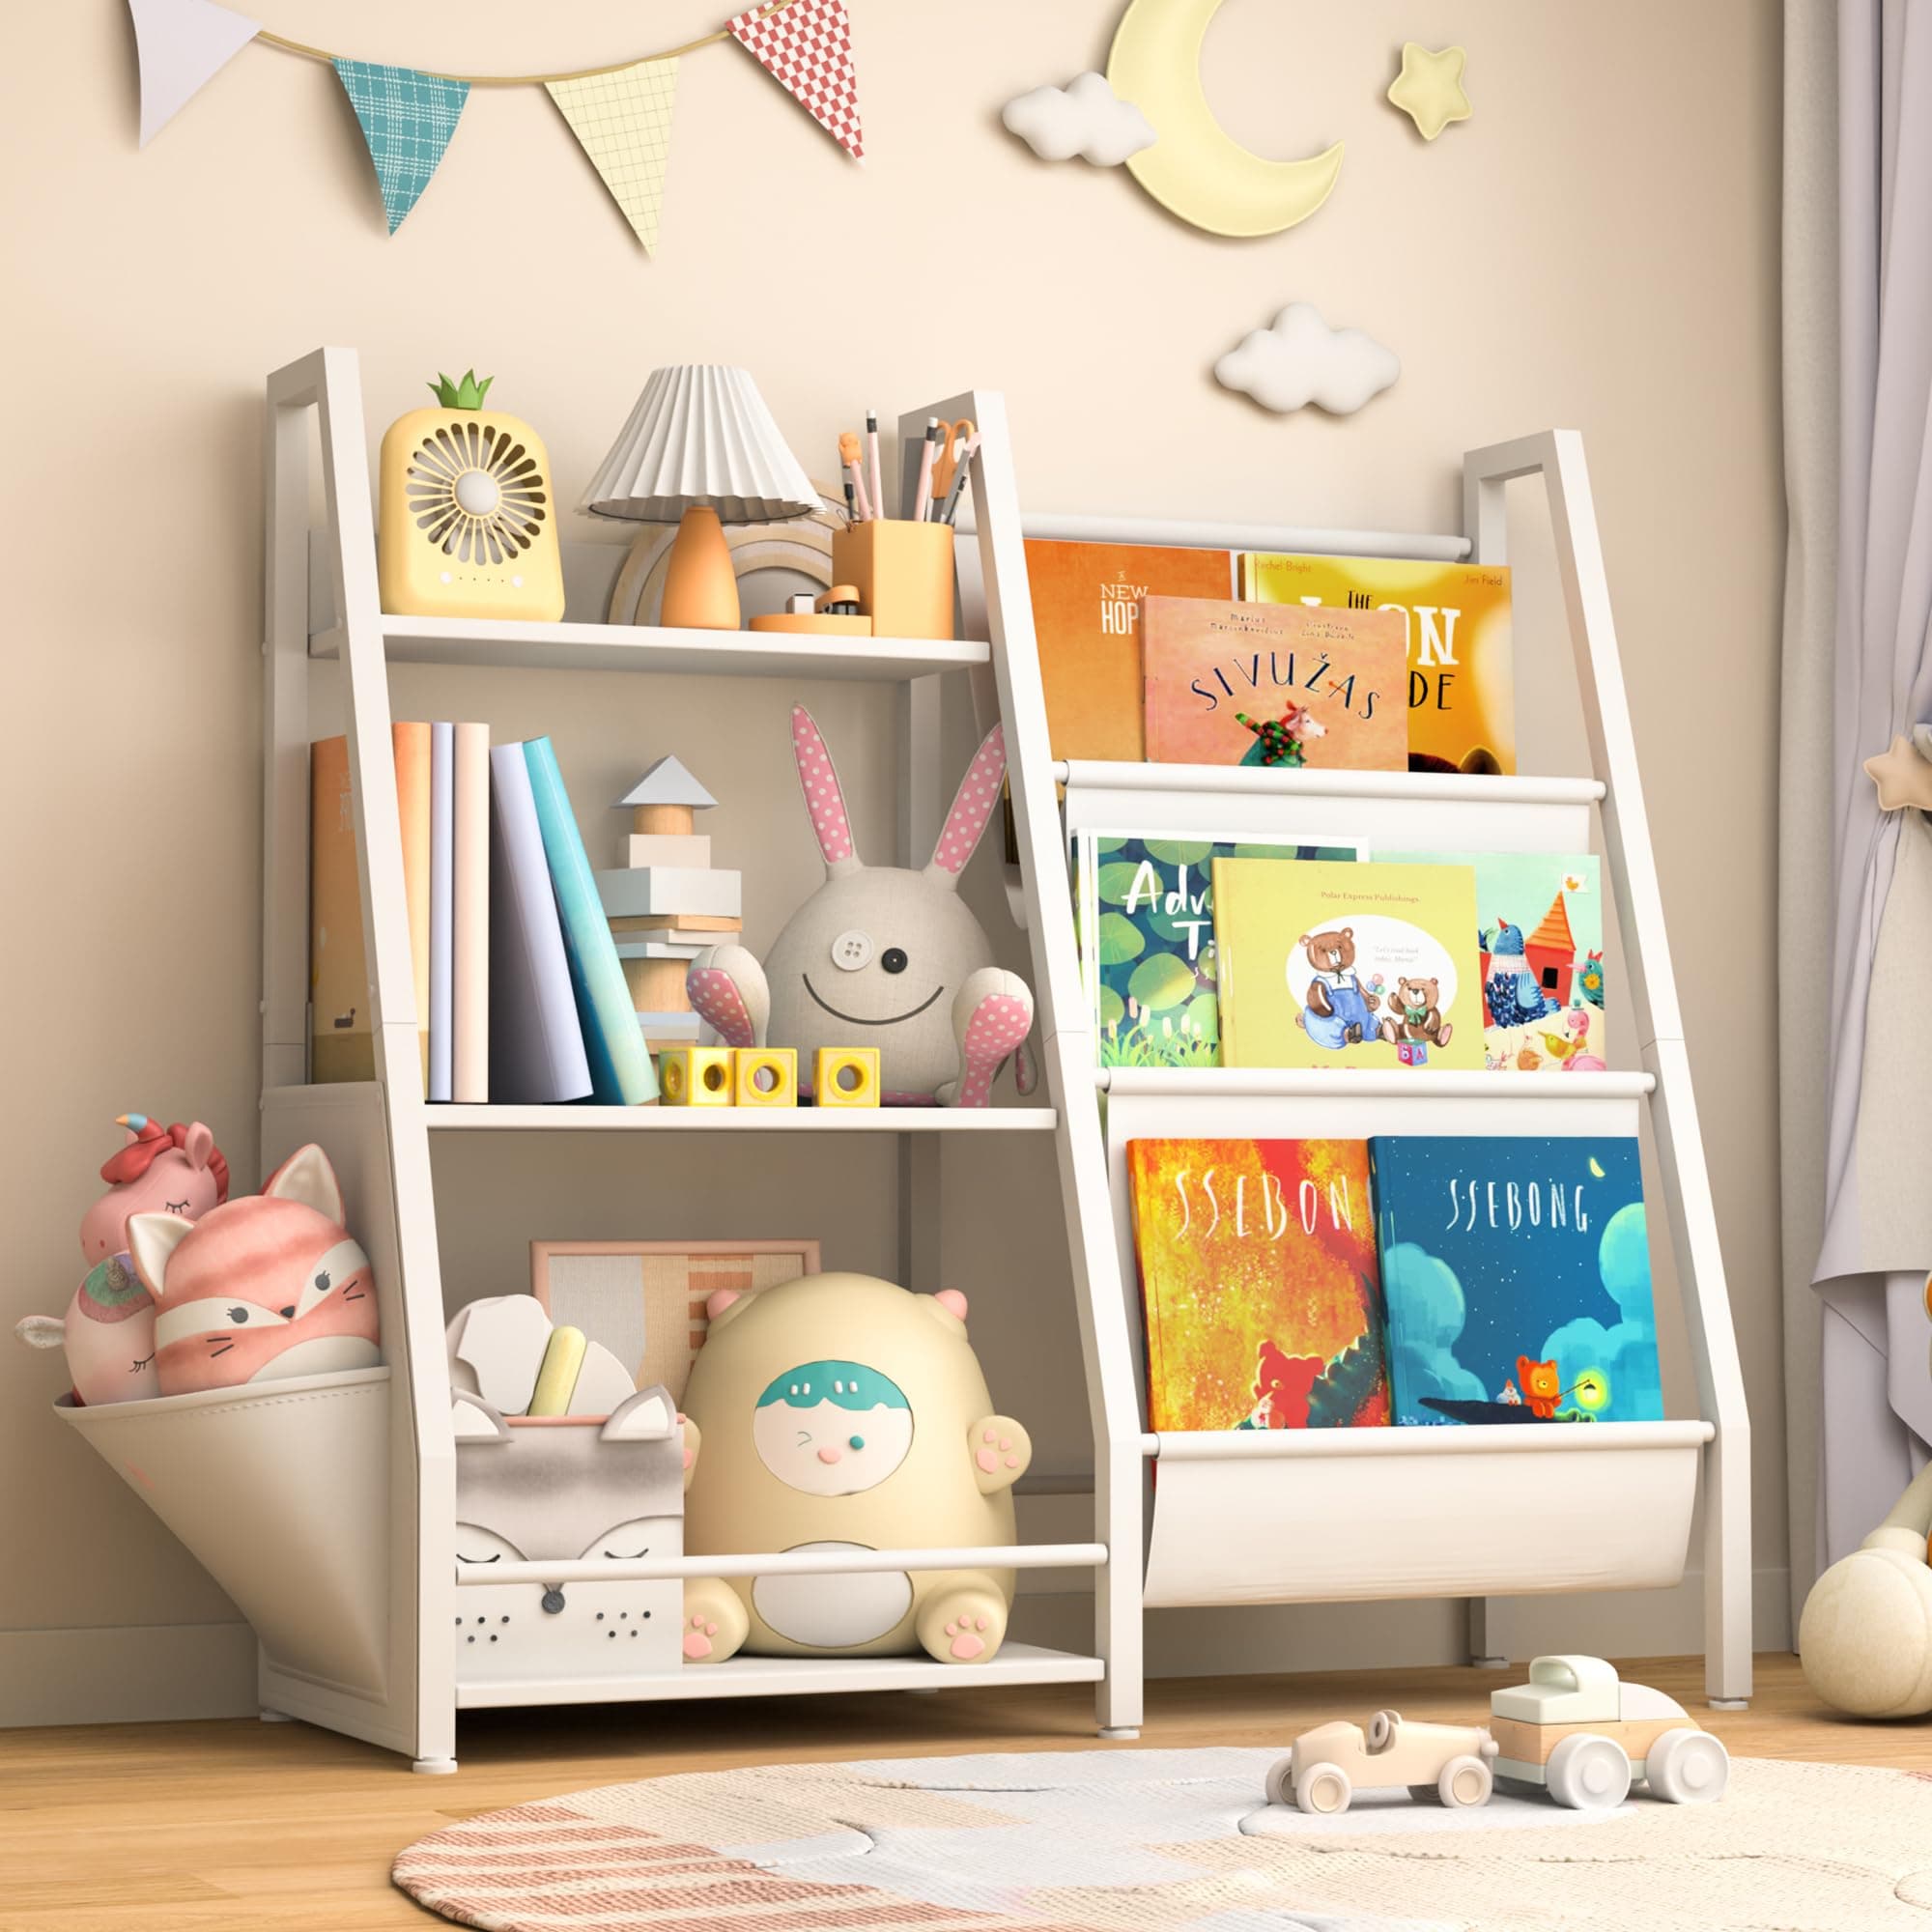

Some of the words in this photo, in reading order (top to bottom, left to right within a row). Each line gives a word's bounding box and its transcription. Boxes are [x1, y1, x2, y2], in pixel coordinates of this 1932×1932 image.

[1286, 560, 1312, 575] Bright
[1463, 573, 1480, 585] Jim
[1482, 574, 1502, 586] Field
[1100, 582, 1150, 600] NEW
[1348, 590, 1374, 610] THE
[1101, 600, 1140, 635] HOP
[1190, 651, 1381, 720] SIVUŽAS
[1121, 860, 1214, 916] Adv
[1321, 891, 1341, 899] Polar
[1343, 893, 1373, 901] Express
[1175, 1170, 1372, 1241] SSEBON
[1446, 1179, 1588, 1233] SSEBONG
